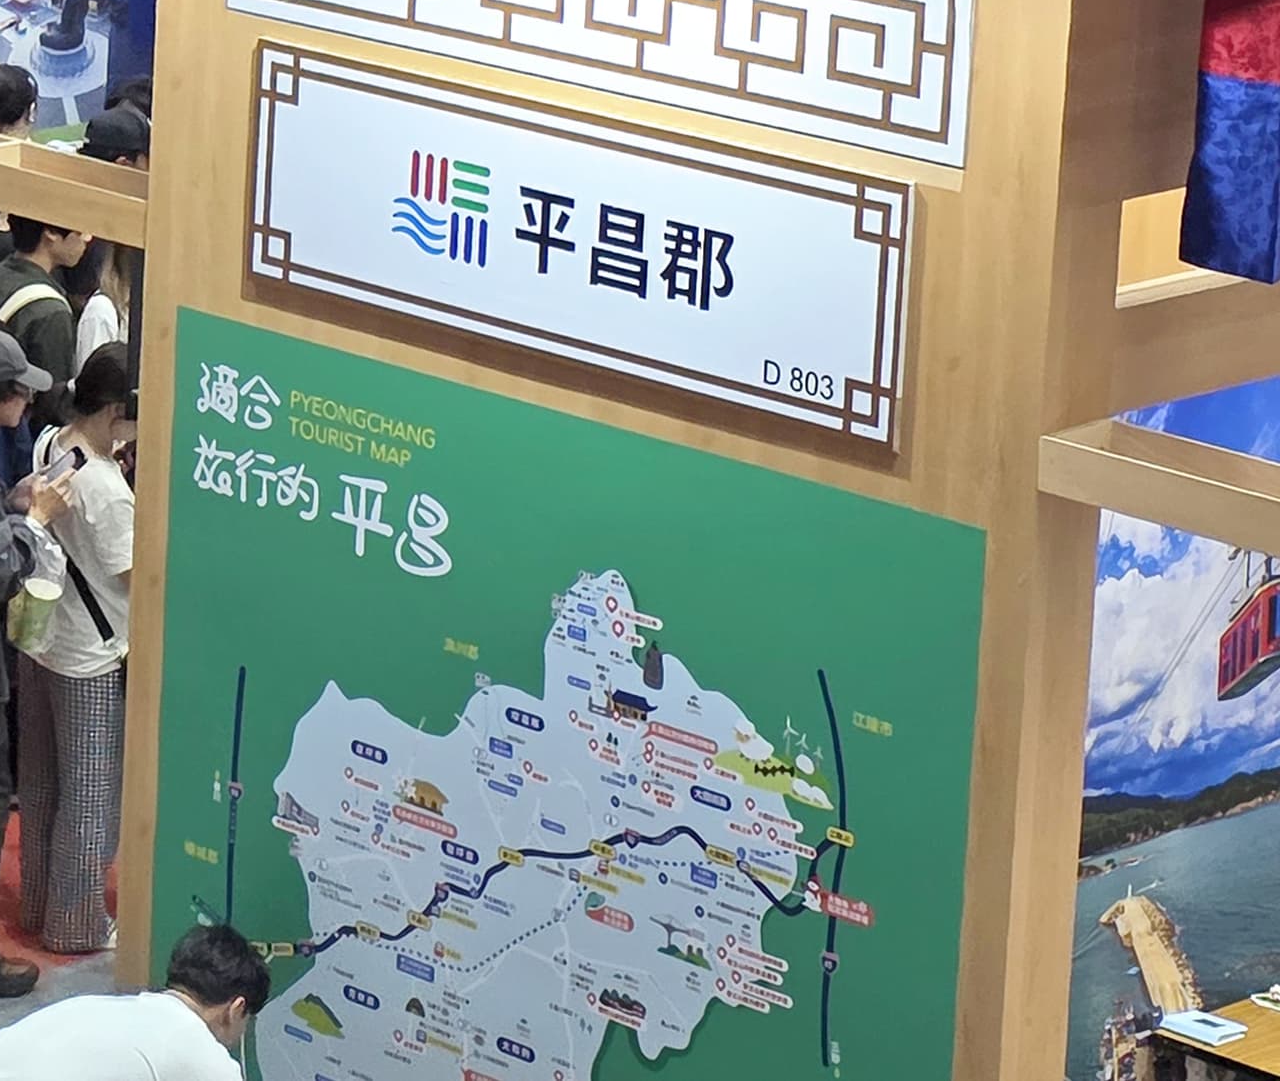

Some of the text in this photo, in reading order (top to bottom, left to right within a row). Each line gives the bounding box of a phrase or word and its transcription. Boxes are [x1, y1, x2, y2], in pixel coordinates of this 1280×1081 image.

[515, 185, 735, 311] 平昌郡
[197, 362, 281, 431] 適合
[762, 359, 835, 401] D 803
[289, 389, 437, 450] PYEONGCHANG
[289, 415, 412, 468] TOURIST MAP
[193, 434, 320, 521] 旅行的
[331, 473, 454, 577] 平昌
